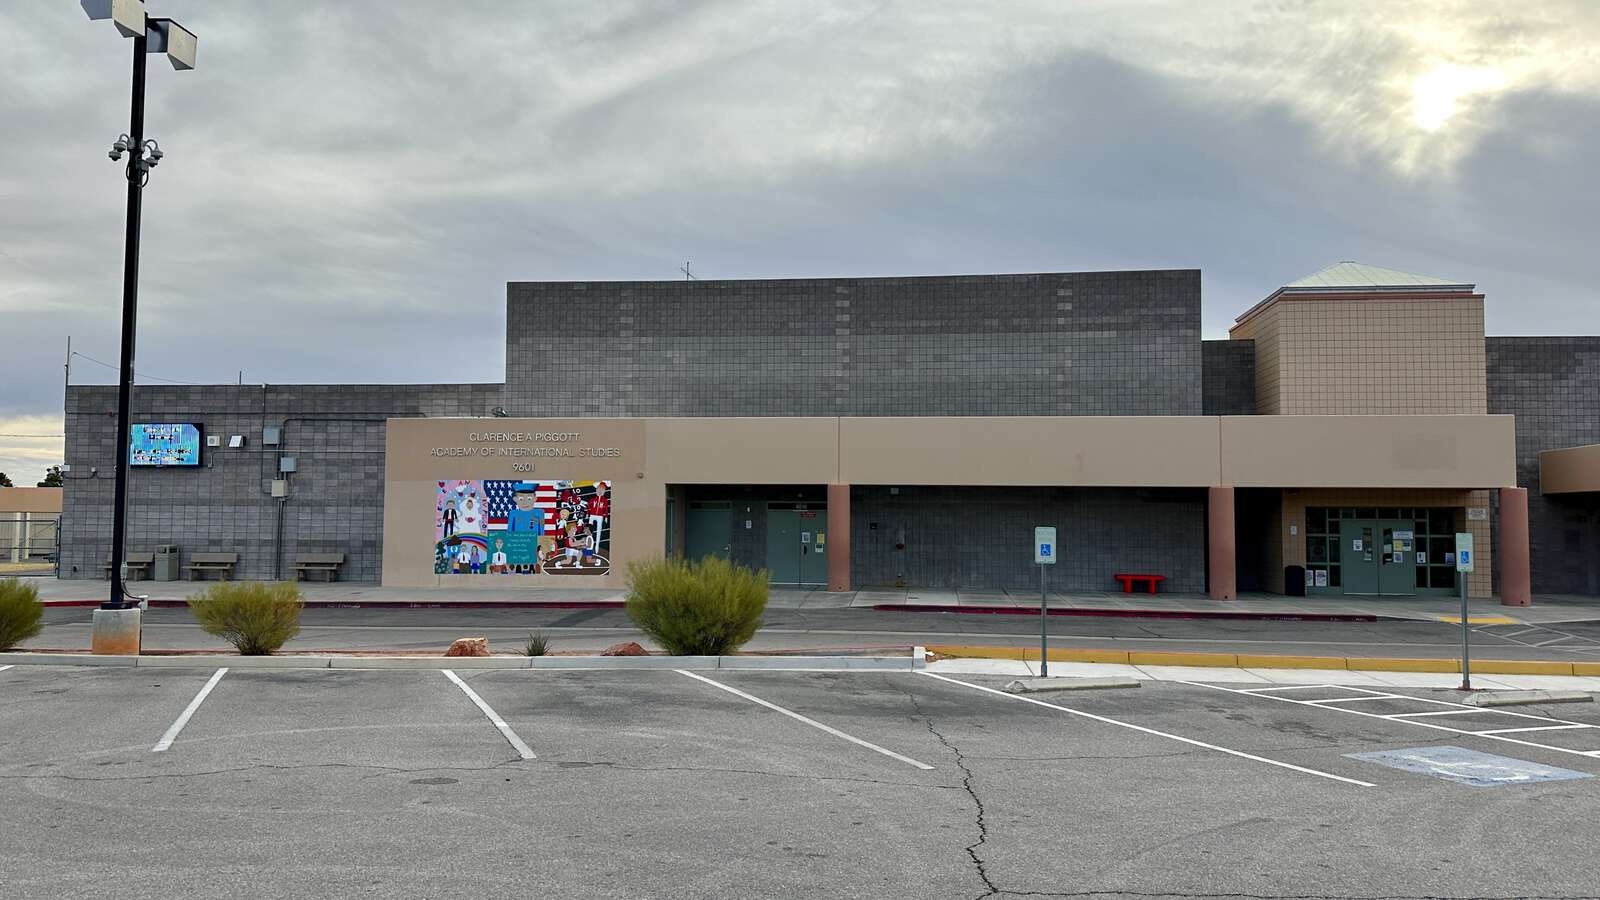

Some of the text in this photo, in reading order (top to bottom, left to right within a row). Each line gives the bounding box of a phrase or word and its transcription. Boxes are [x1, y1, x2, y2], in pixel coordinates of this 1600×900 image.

[469, 432, 581, 442] CLARENCE A PIGGOTT
[430, 447, 621, 458] ACADEMY OF INTERNATIONAL STUDIES
[512, 462, 536, 473] 9601
